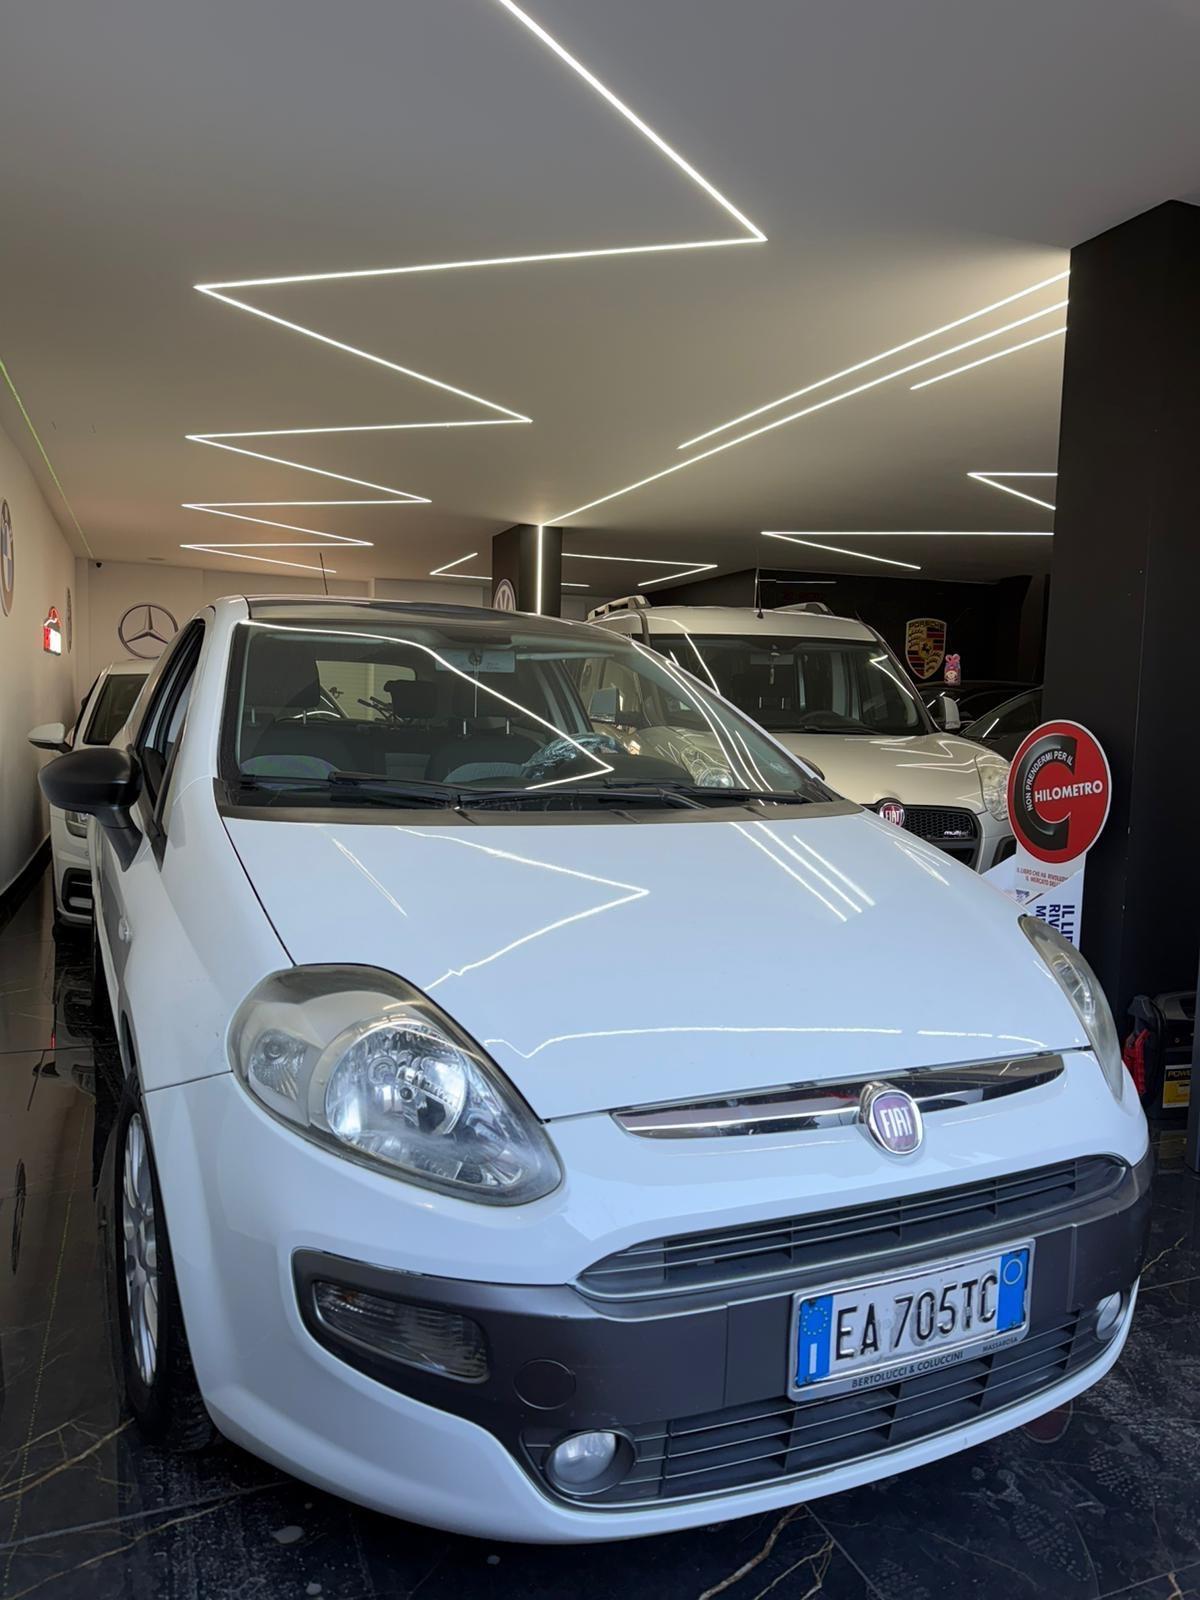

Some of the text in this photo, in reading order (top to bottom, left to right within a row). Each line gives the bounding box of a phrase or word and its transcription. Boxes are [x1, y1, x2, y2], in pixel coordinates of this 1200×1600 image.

[1025, 750, 1074, 812] NON PRENDERMI PER IL
[885, 807, 900, 824] FIAT
[1061, 904, 1075, 919] IL
[880, 1106, 913, 1139] FIAT
[835, 1272, 998, 1361] EA 705TC
[851, 1366, 908, 1388] BERTOLUCCI
[917, 1351, 964, 1372] COLUCCINI
